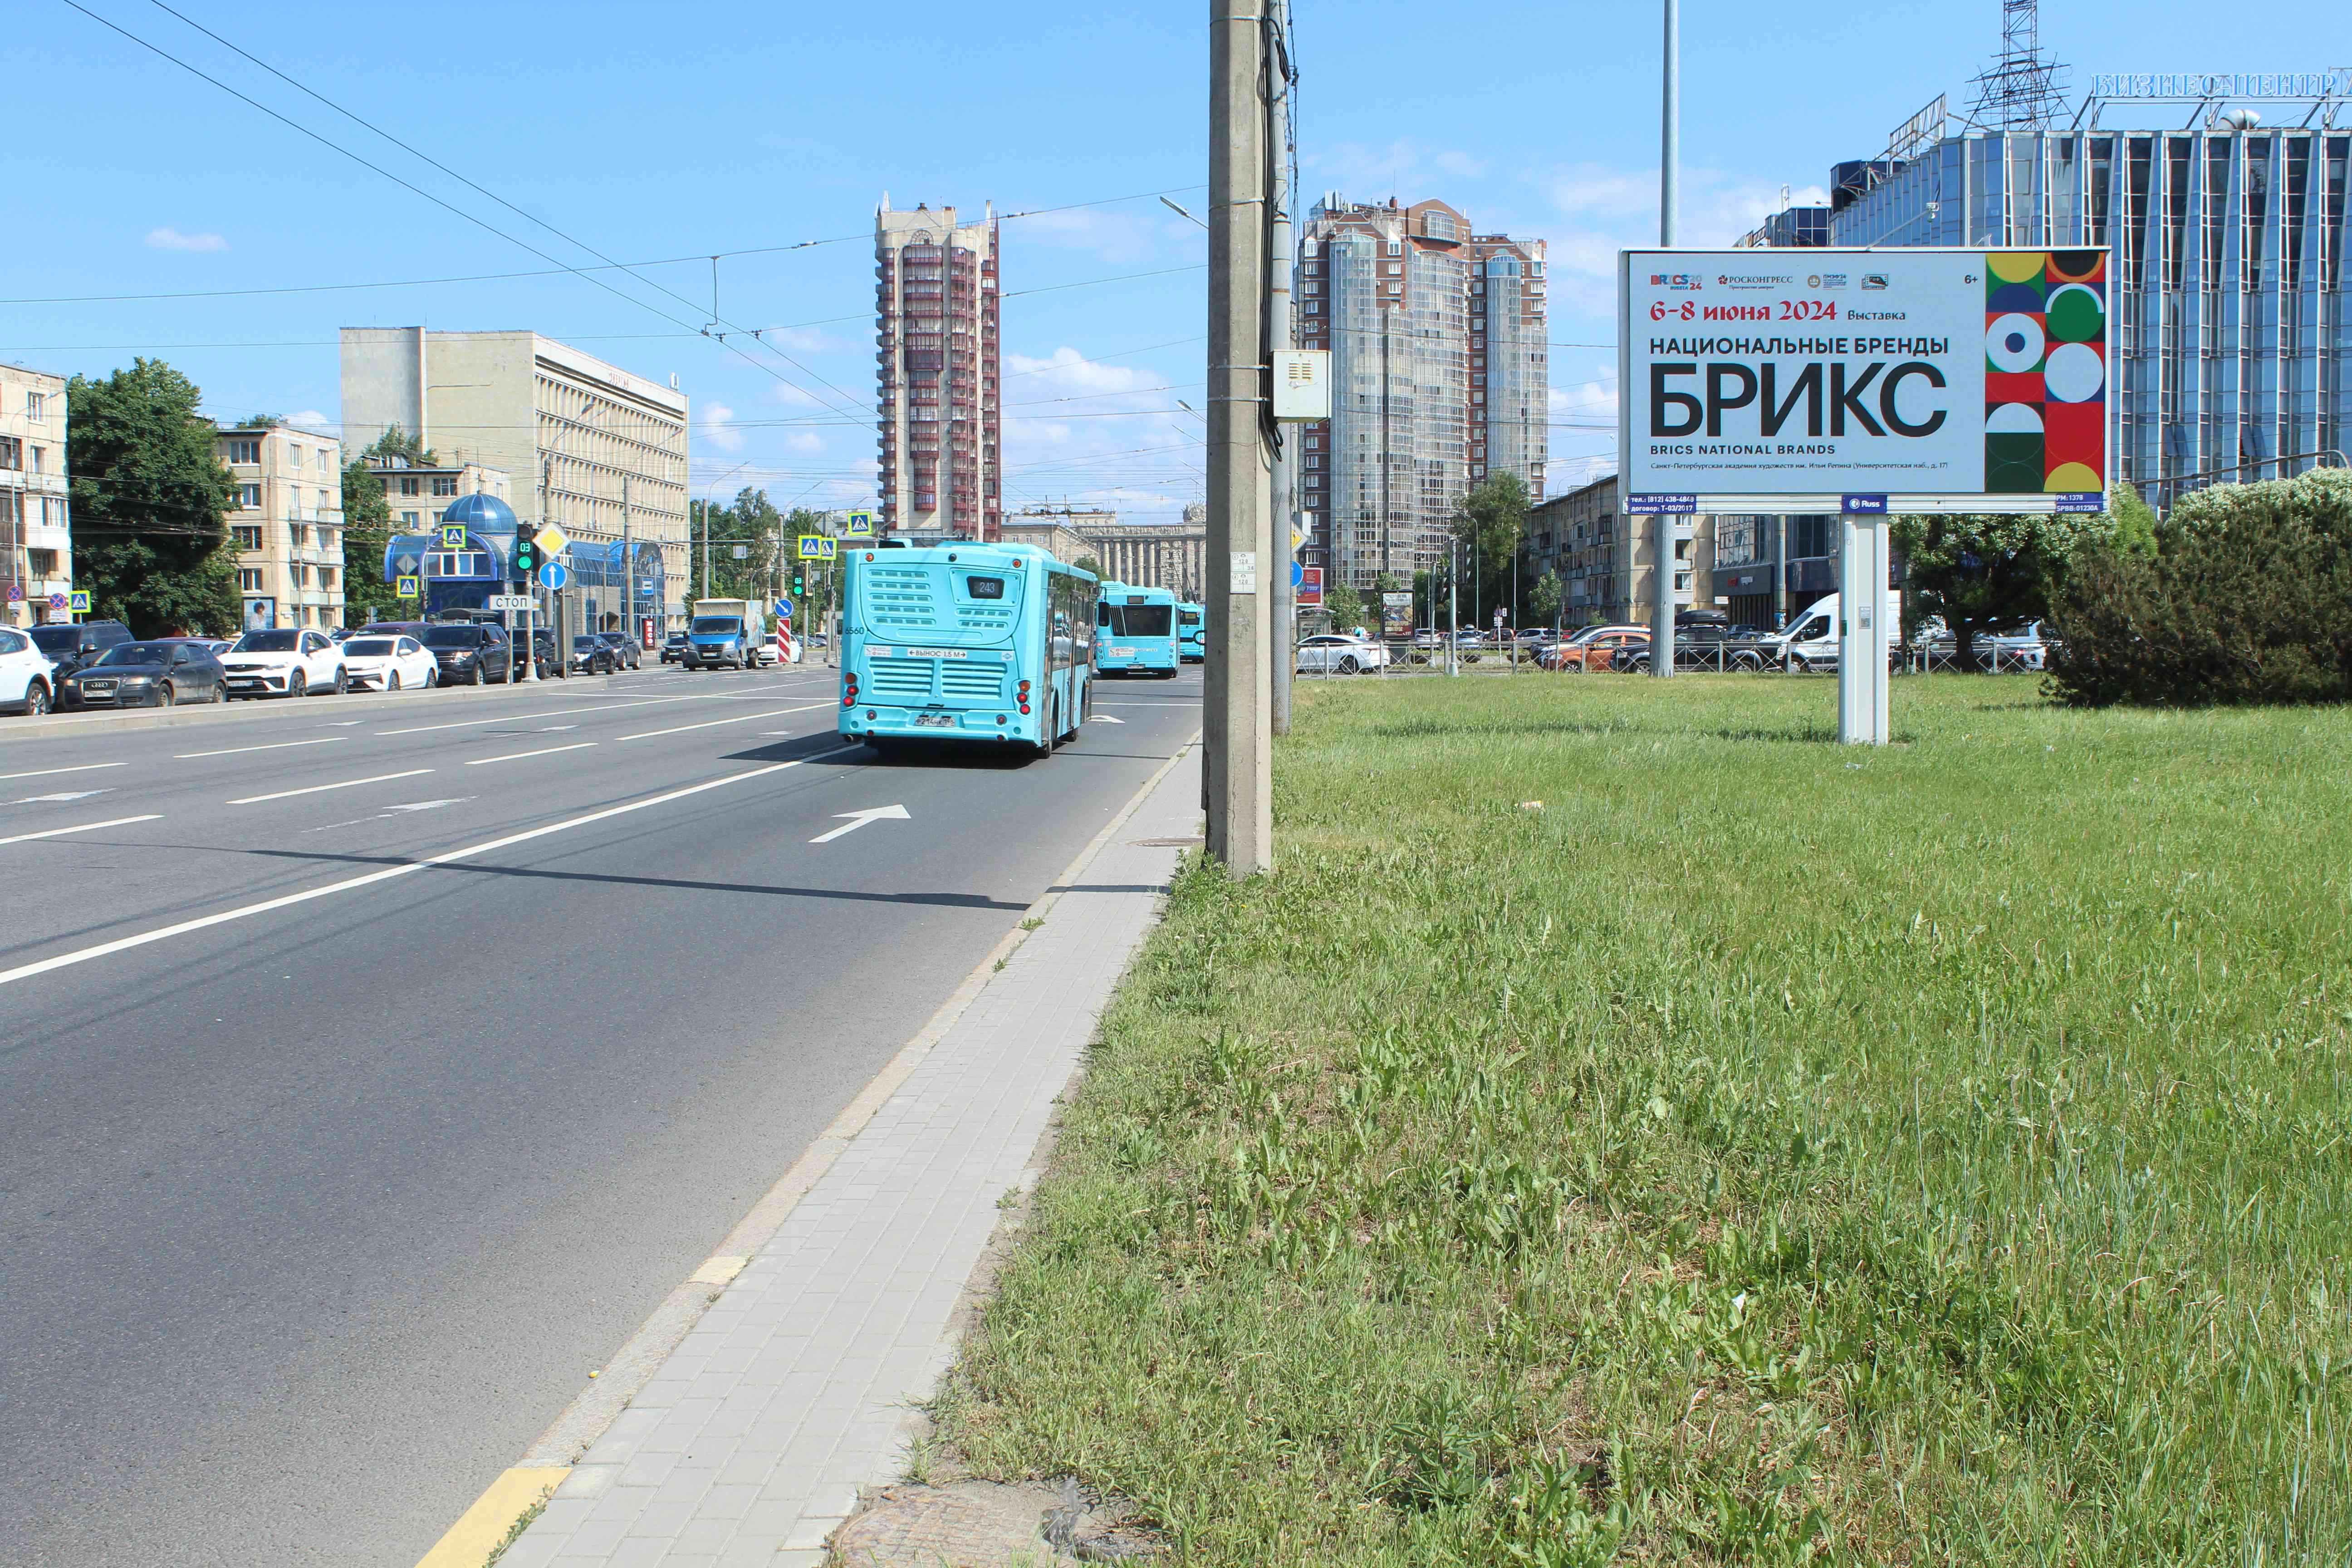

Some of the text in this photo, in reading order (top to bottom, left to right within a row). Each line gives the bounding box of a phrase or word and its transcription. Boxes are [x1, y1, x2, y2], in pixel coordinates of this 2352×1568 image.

[2091, 73, 2337, 99] БИЗНЕС-ЦЕНТР
[1964, 275, 1978, 284] 6+
[1703, 306, 1770, 320] июня
[1778, 300, 1838, 320] 2024
[1847, 310, 1906, 320] Выставка
[1650, 338, 1948, 357] НАЦИОНАЛЬНЫЕ БРЕНДЫ
[1650, 362, 1947, 437] БРИКС
[1651, 445, 1835, 454] BRICS NATIONAL BRANDS
[1651, 462, 1723, 470] Санкт-Петербургская
[1853, 462, 1911, 470] (Университетская
[520, 543, 530, 552] 03
[980, 582, 995, 593] 243
[496, 598, 527, 607] СТОП
